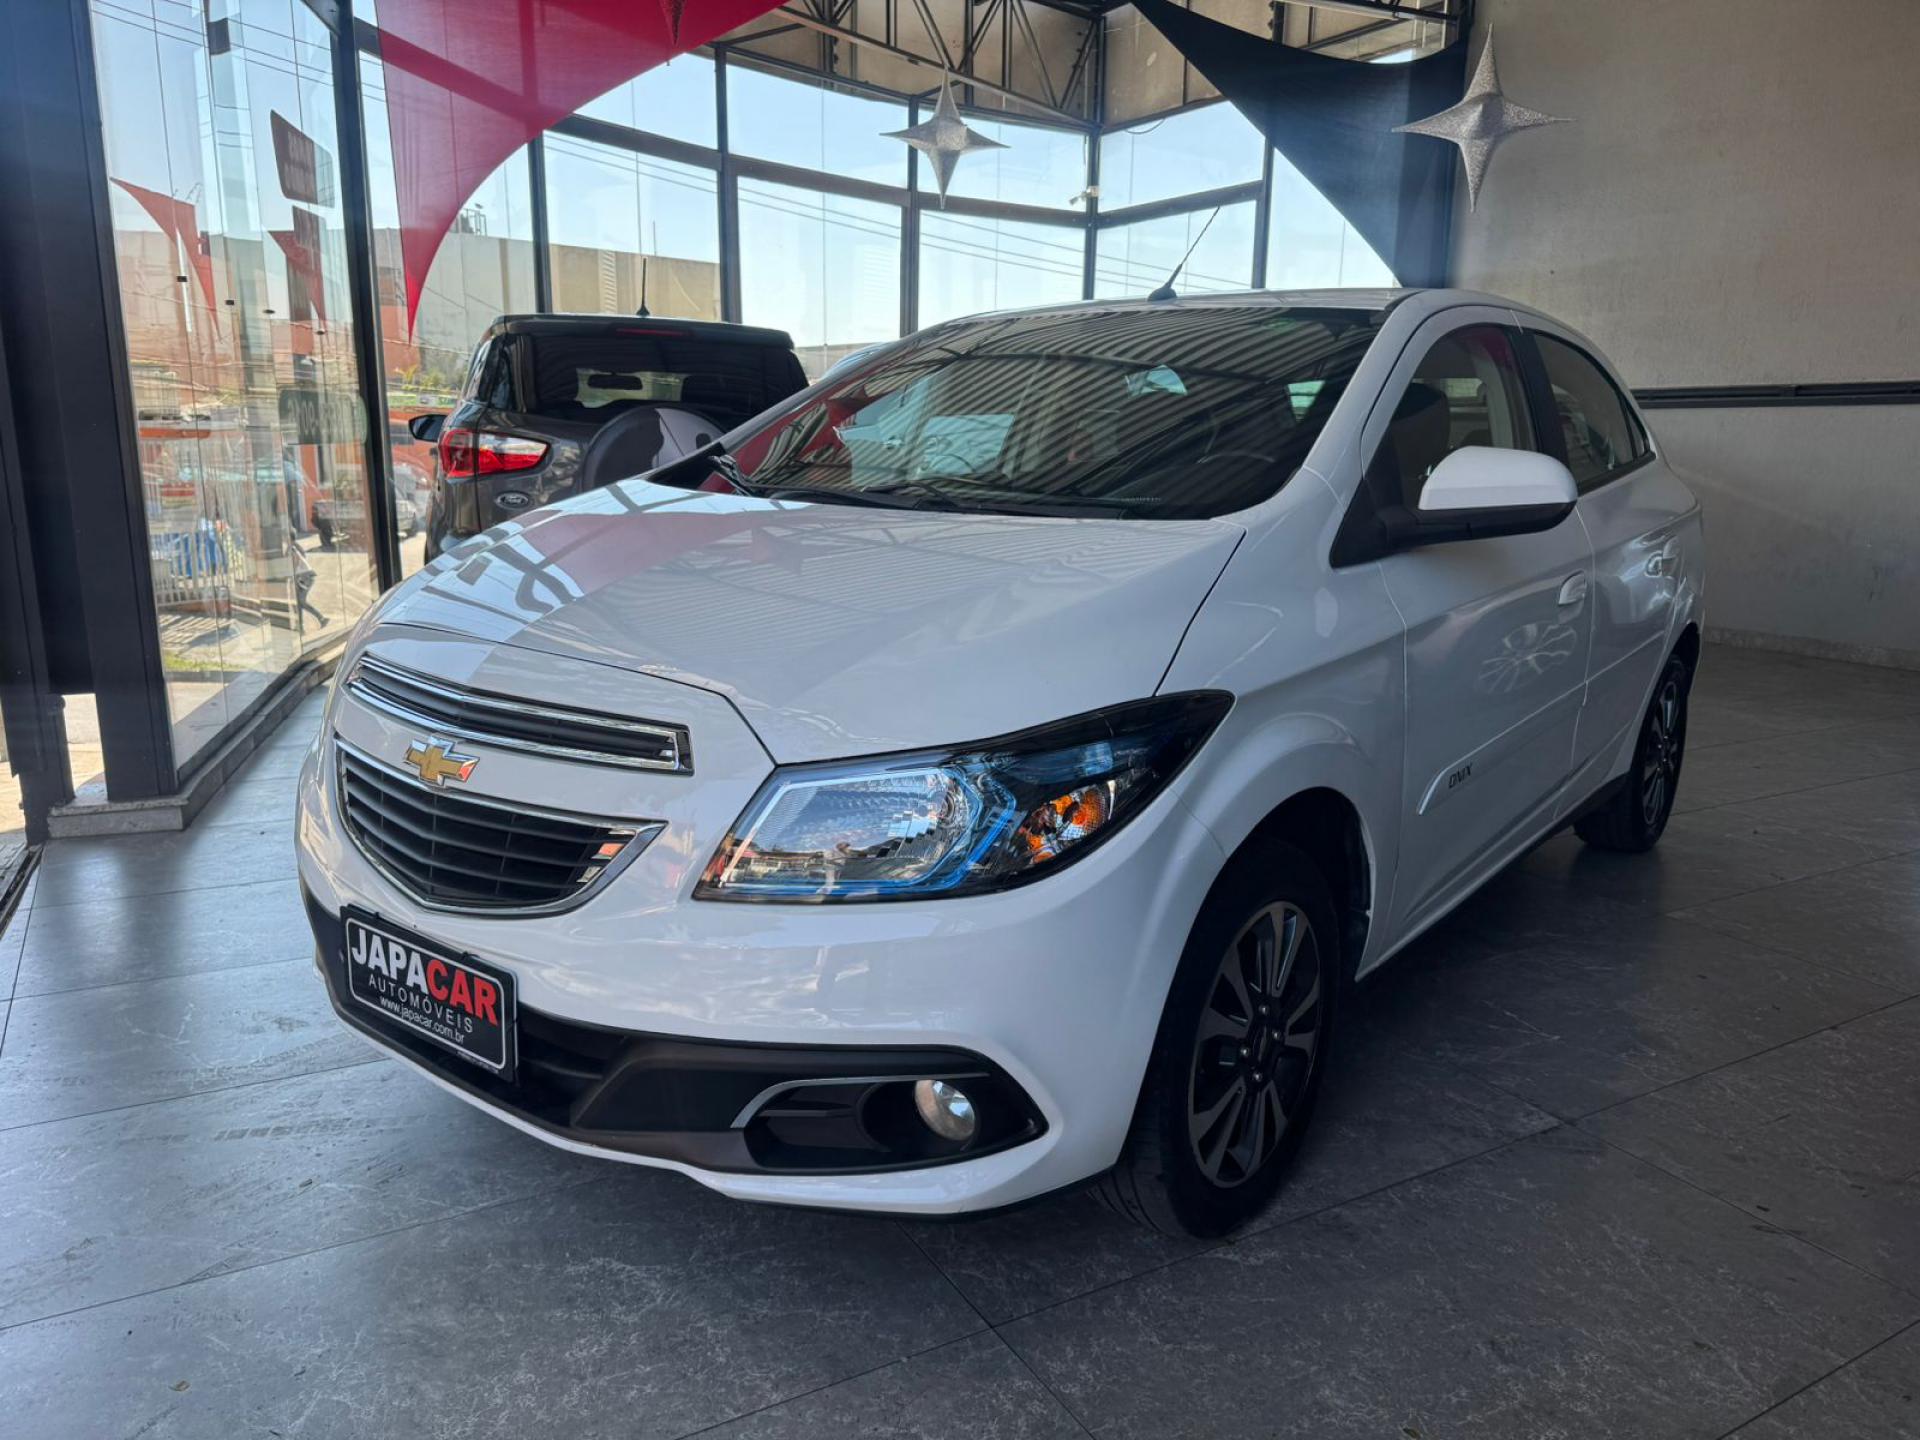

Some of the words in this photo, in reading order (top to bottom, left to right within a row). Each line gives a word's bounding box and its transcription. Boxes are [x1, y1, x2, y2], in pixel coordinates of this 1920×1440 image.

[351, 928, 498, 1026] JAPACAR
[368, 974, 473, 1033] AUTOMÓVEIS
[379, 996, 465, 1045] www.japacar.com.br
